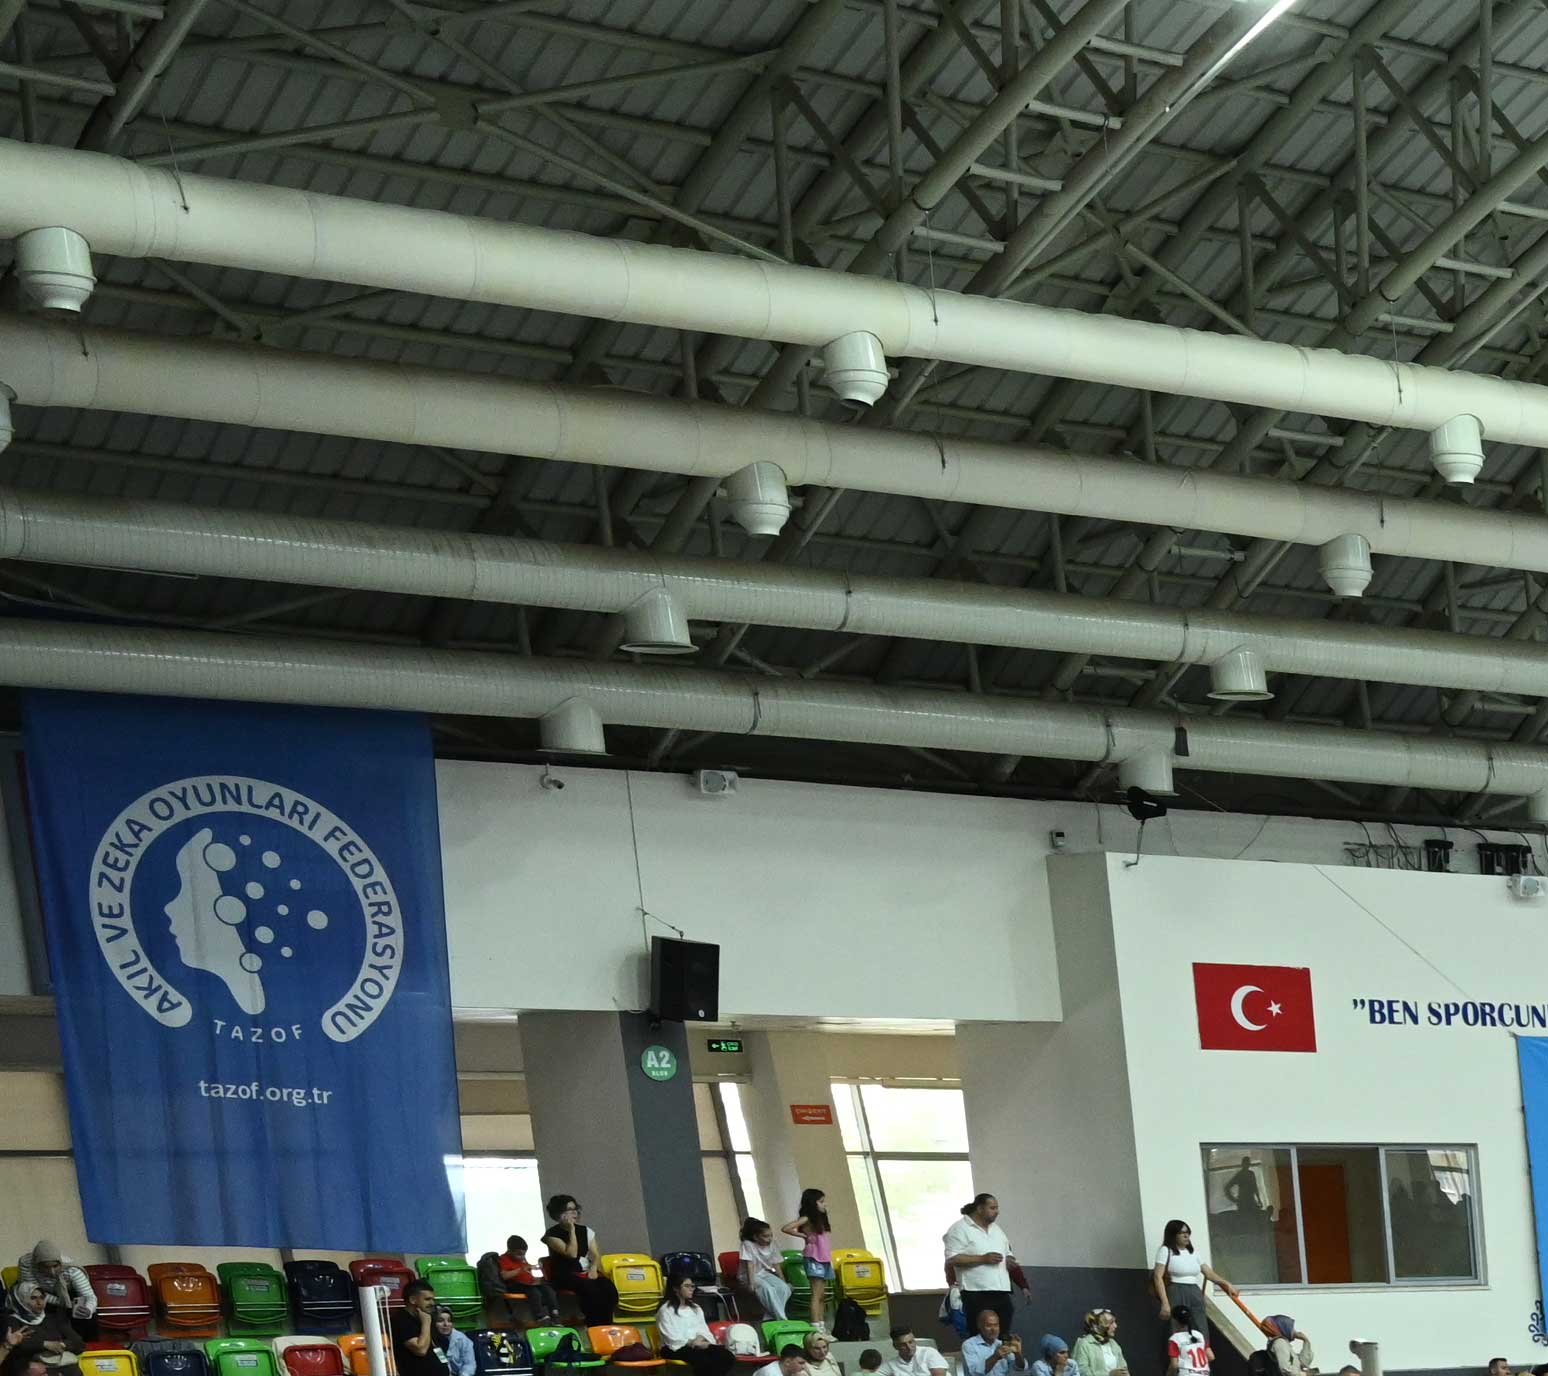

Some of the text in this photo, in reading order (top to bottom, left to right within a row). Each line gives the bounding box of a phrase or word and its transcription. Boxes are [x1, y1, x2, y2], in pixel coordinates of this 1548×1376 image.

[97, 782, 396, 1036] AKIL VE ZEKA OYUNLARI FEDERASYONU
[213, 1020, 302, 1042] TAZOF
[647, 1051, 671, 1068] A2
[198, 1079, 333, 1107] tazof.org.tr
